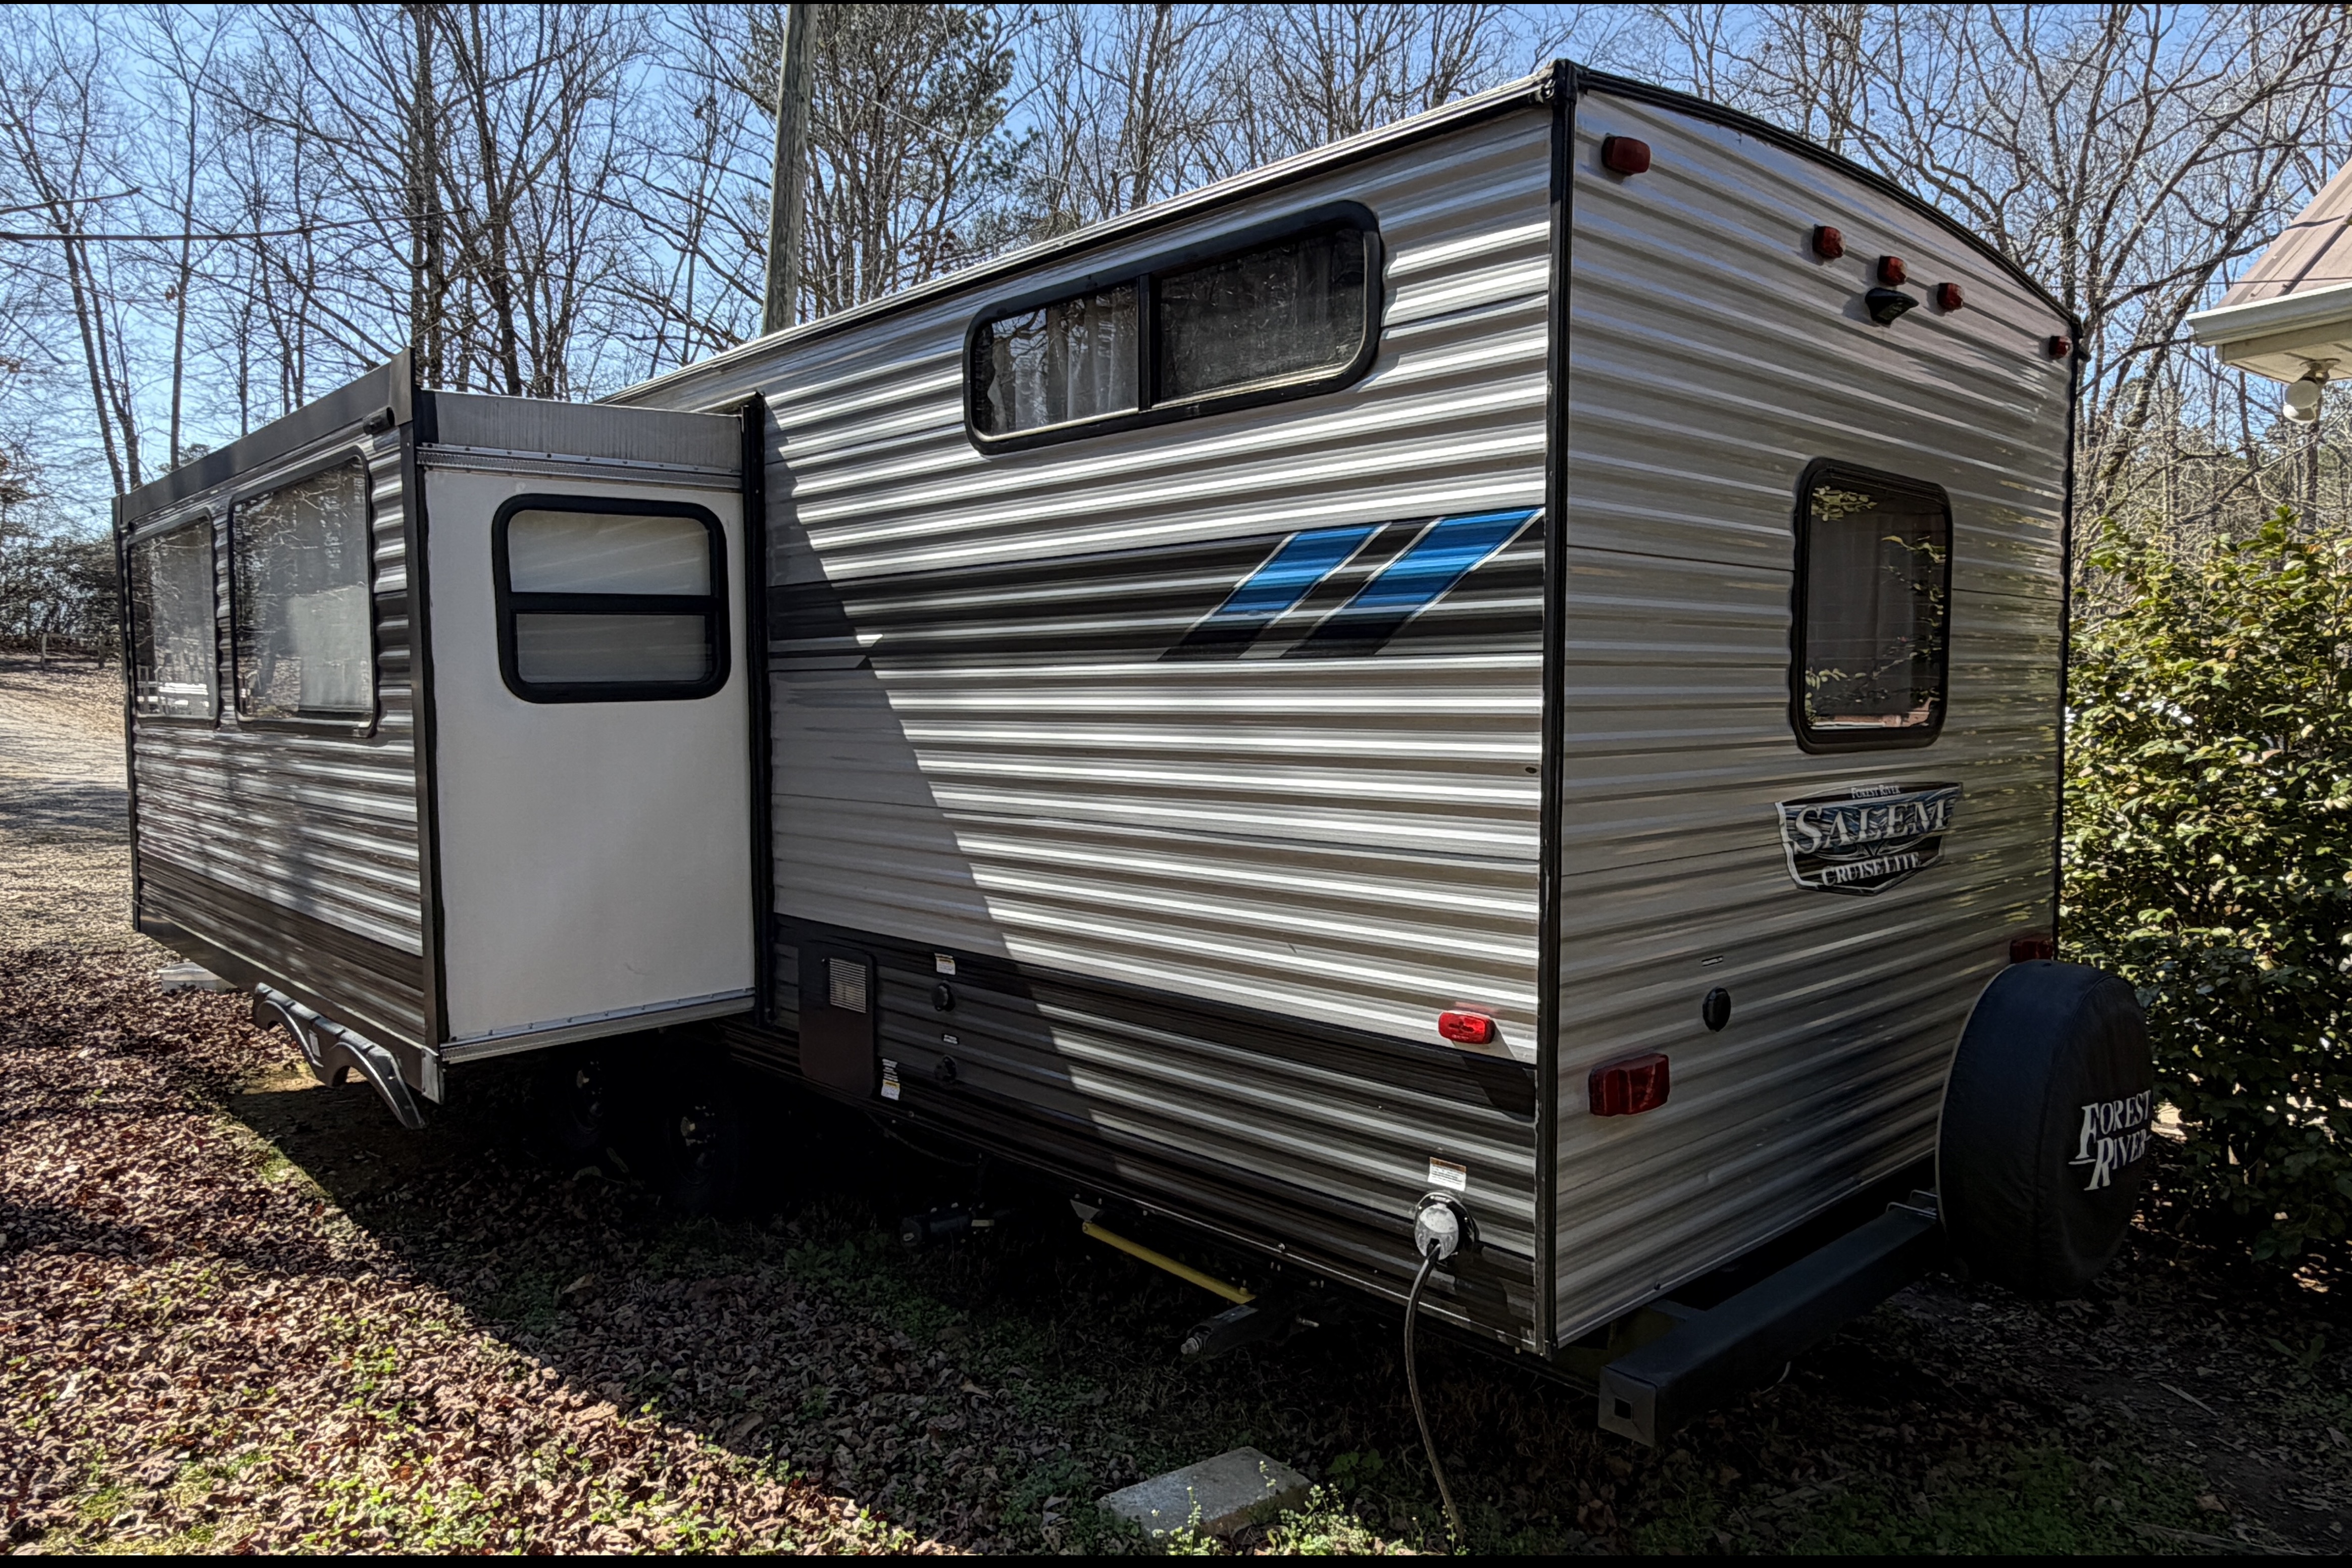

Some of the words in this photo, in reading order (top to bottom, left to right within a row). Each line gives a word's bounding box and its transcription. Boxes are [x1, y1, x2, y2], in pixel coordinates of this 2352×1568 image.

[1793, 799, 1947, 854] SALEM
[2075, 1089, 2151, 1159] FOREST
[2083, 1129, 2151, 1191] RIVER
